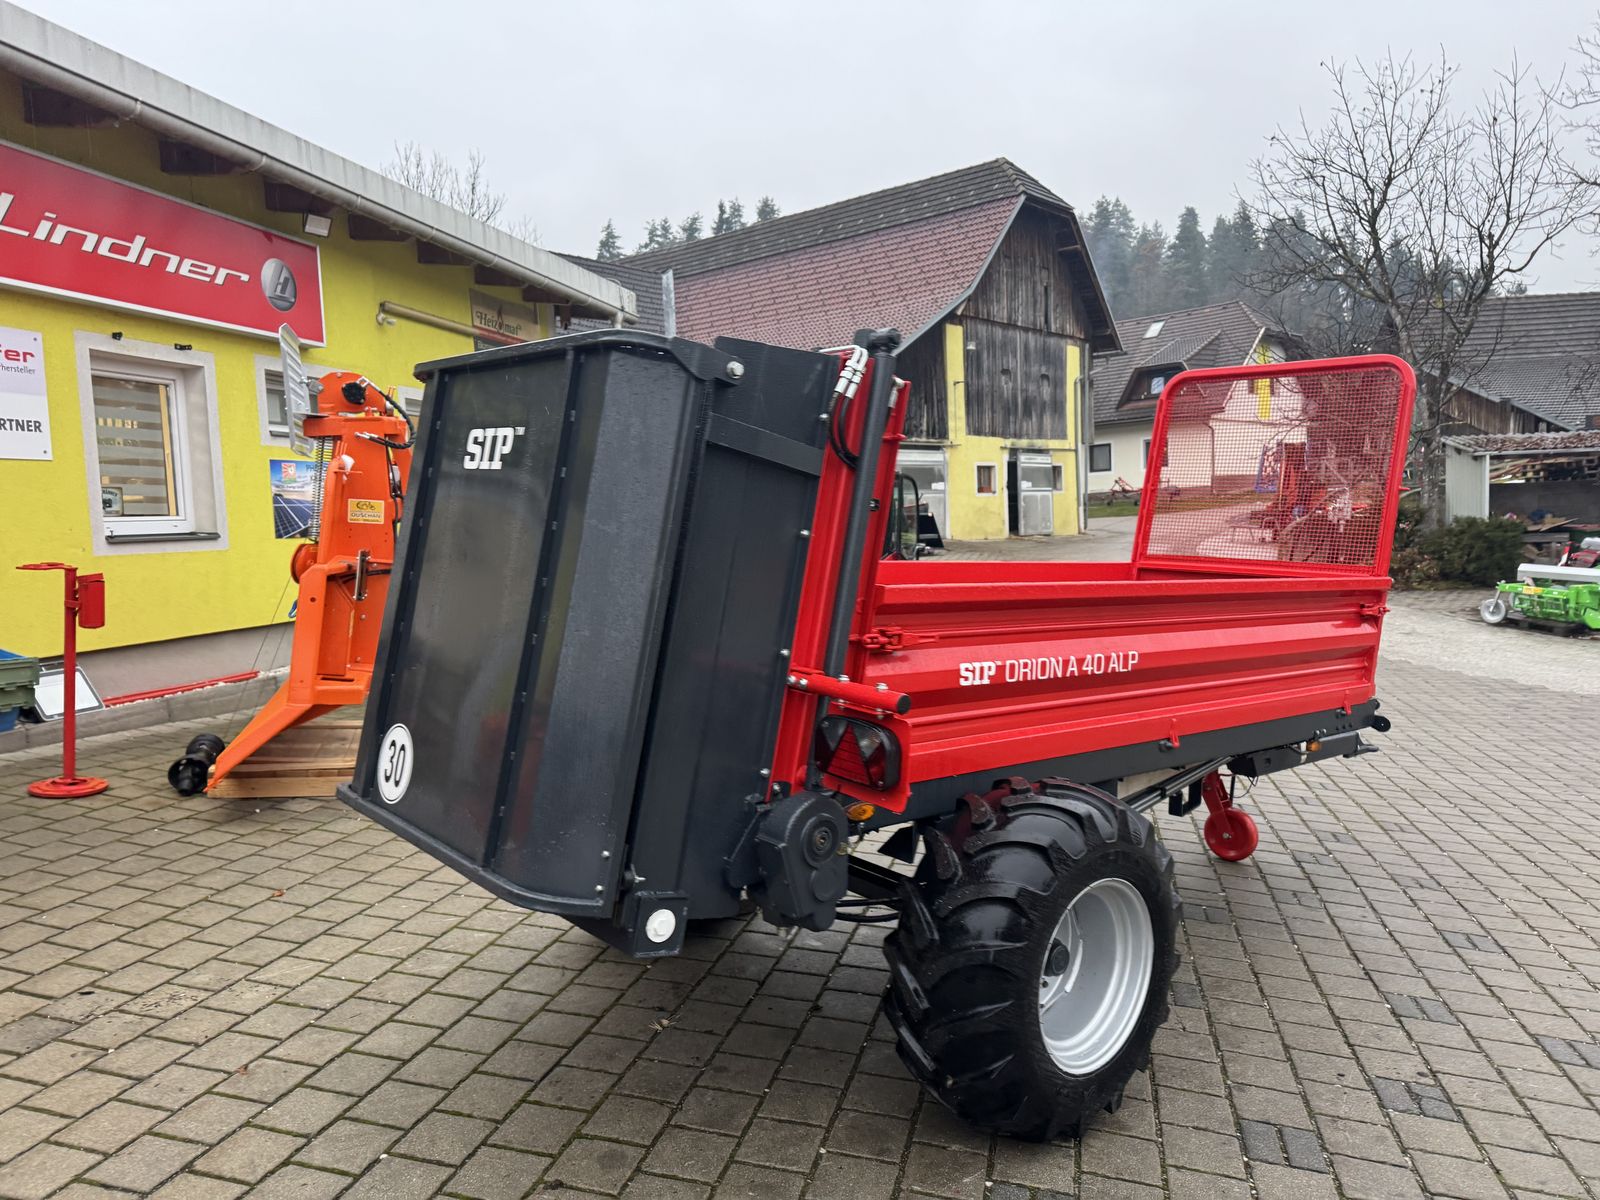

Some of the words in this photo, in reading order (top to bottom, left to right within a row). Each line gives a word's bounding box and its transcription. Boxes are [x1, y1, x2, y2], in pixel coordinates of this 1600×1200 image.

[0, 192, 250, 286] Lindner
[0, 344, 35, 363] er
[1005, 656, 1062, 682] ORION
[1066, 655, 1079, 677] A
[1082, 653, 1103, 675] 40
[1107, 651, 1139, 672] ALP
[384, 739, 406, 788] 30
